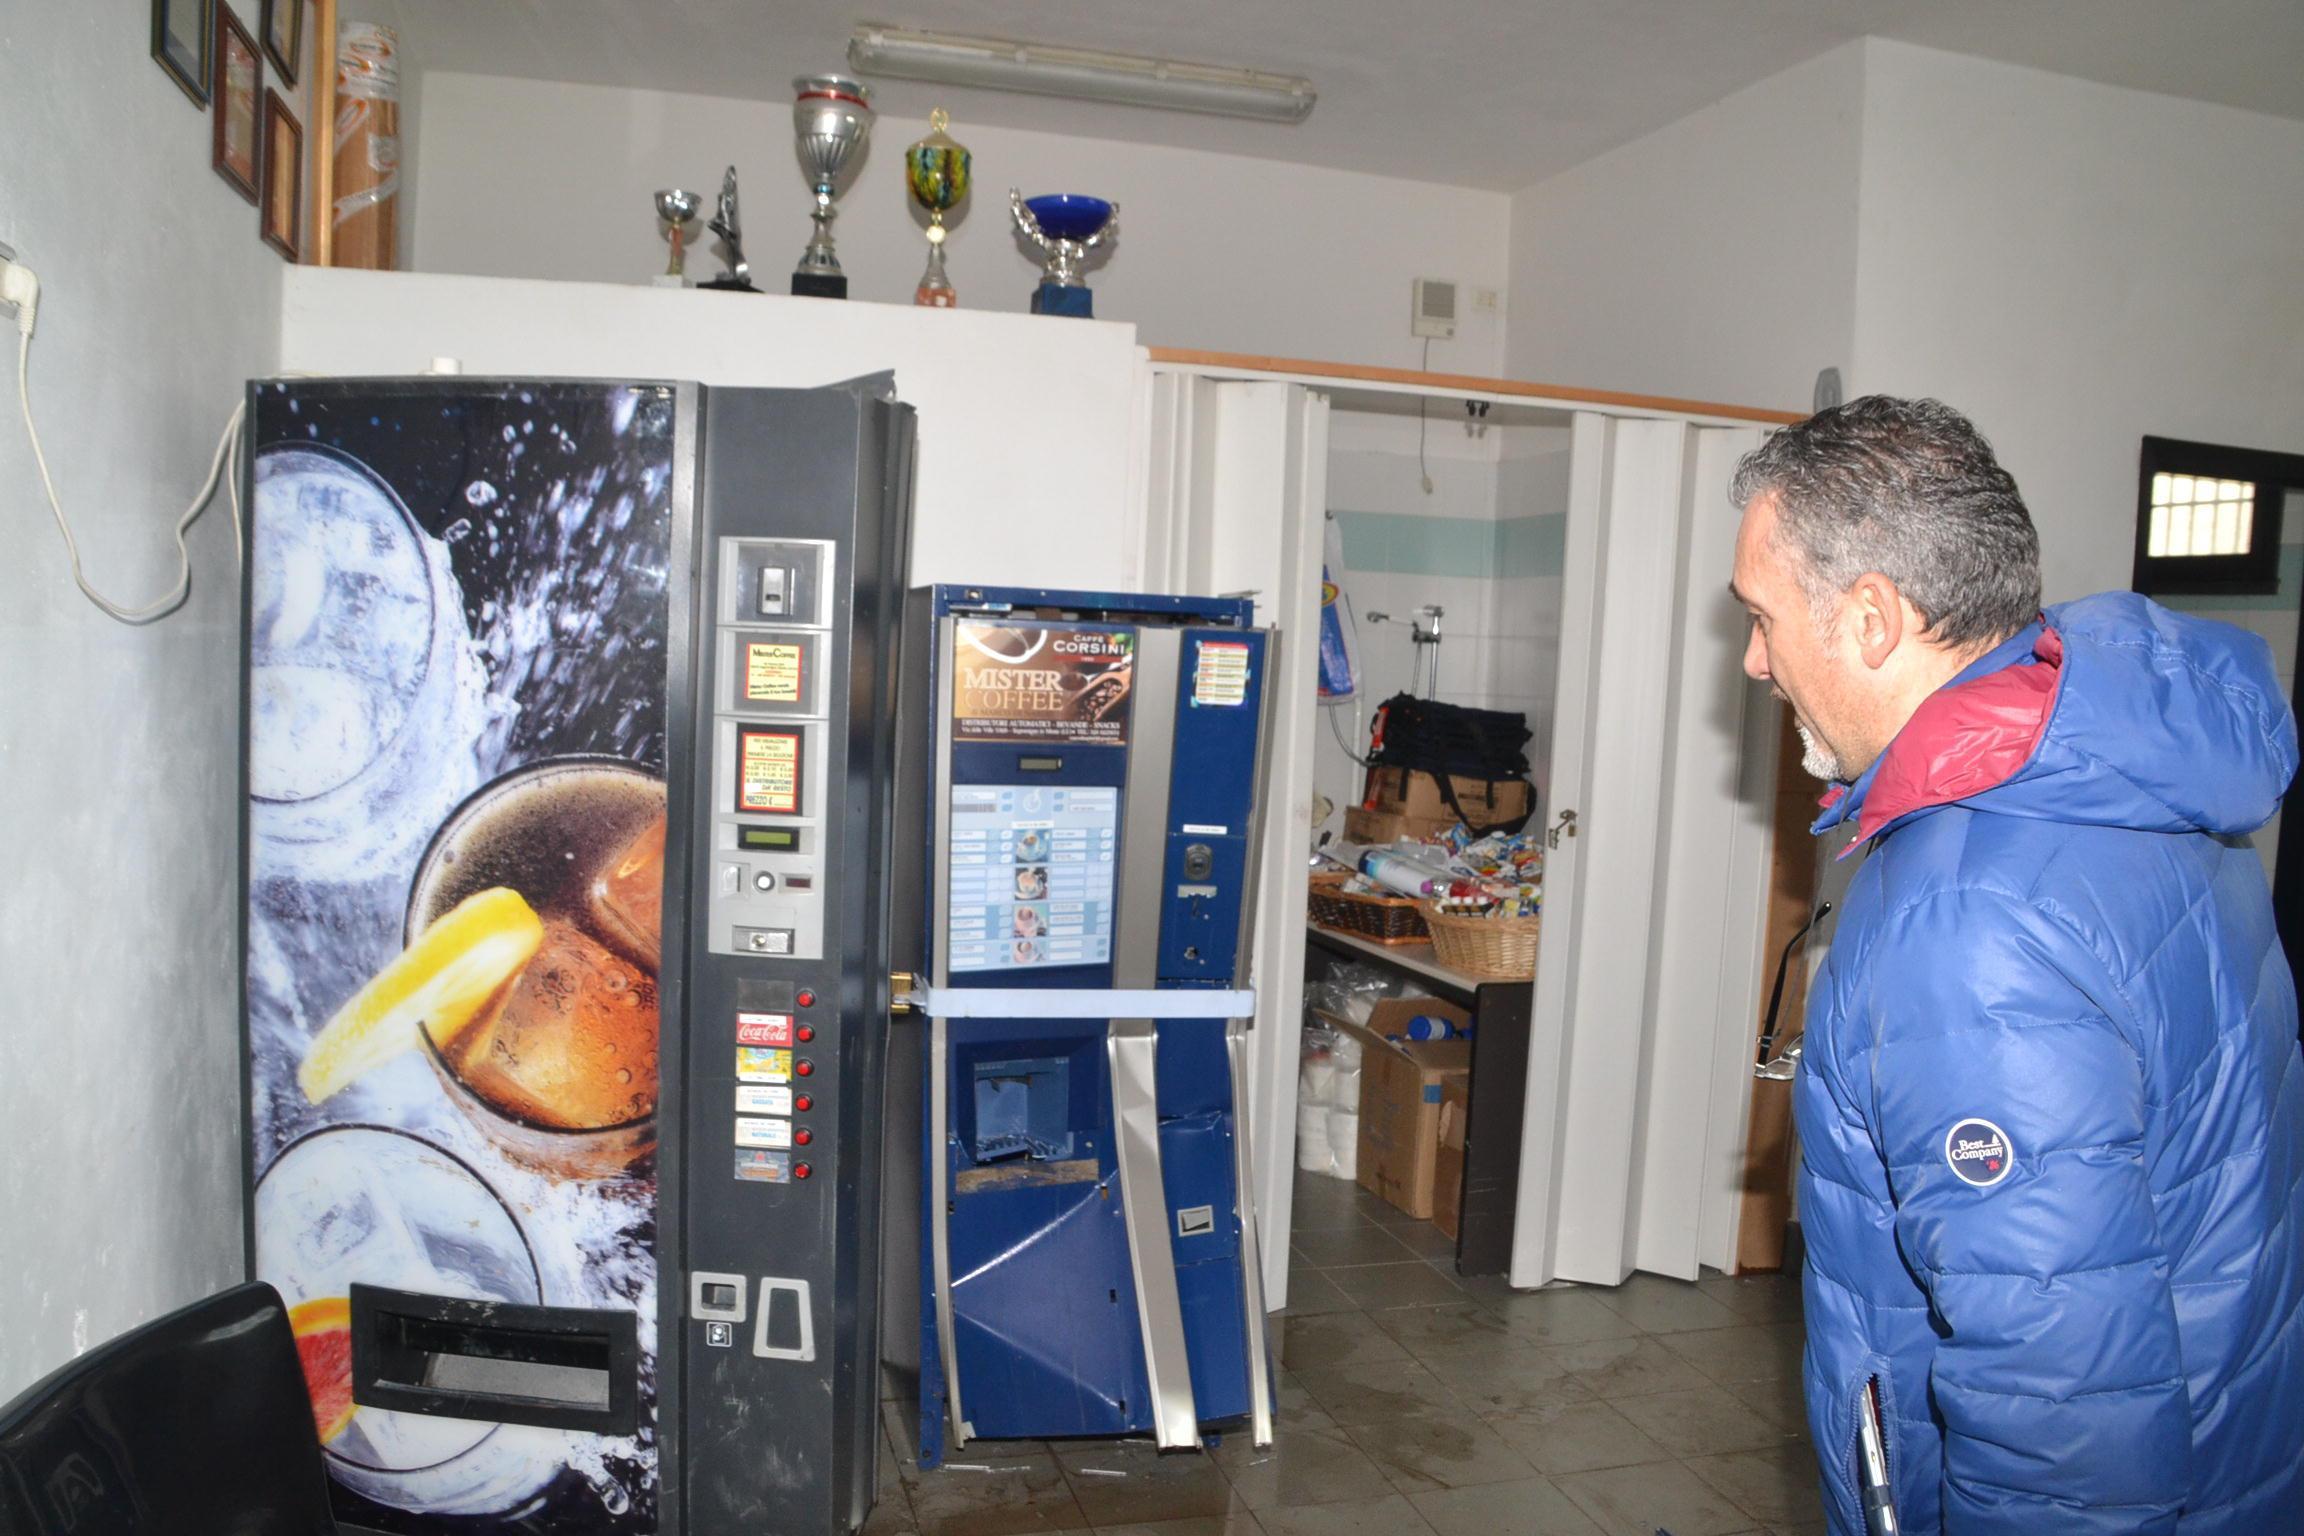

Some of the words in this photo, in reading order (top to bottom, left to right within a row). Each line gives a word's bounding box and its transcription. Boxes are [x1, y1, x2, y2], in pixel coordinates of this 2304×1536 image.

[1053, 639, 1125, 655] CORSINI
[963, 667, 1064, 691] MISTER
[965, 690, 1064, 711] COFFEE
[1951, 1146, 2004, 1160] Company
[1958, 1139, 1985, 1151] Best
